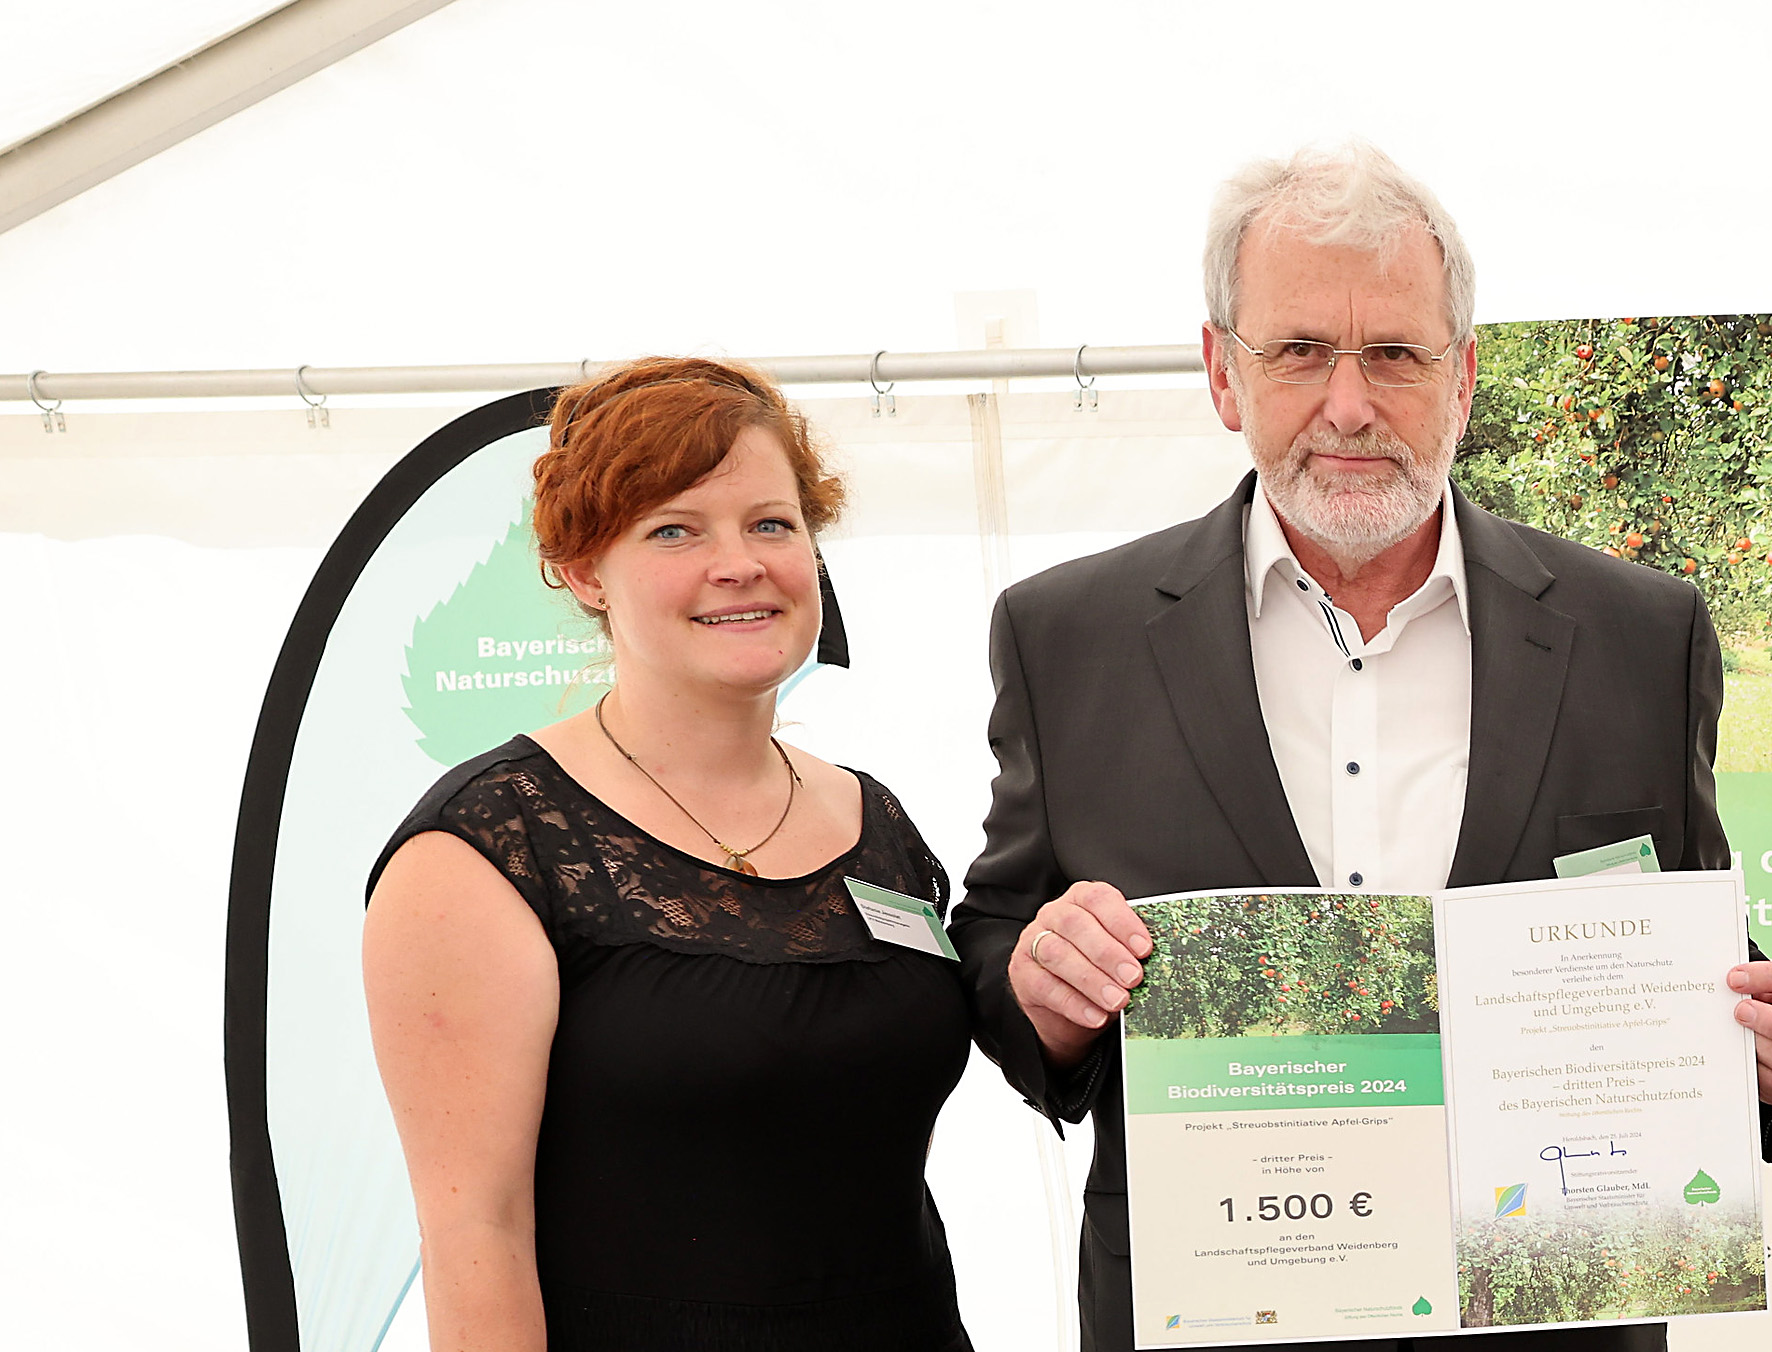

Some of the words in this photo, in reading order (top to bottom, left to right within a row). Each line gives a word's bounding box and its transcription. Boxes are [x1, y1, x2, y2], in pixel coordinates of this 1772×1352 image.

[1529, 918, 1653, 943] URKUNDE
[1560, 953, 1569, 962] In
[1570, 951, 1622, 962] Anerkennung
[1512, 967, 1553, 977] besonderer
[1554, 964, 1594, 974] Verdienste
[1609, 961, 1625, 970] den
[1626, 958, 1673, 968] Naturschutz
[1562, 974, 1592, 984] verleihe
[1593, 973, 1605, 982] ich
[1607, 972, 1624, 981] dem
[1475, 985, 1637, 1006] Landschaftspflegeverband
[1640, 980, 1716, 994] Weidenberg
[1533, 1006, 1557, 1018] und
[1562, 1001, 1631, 1017] Umgebung
[1634, 999, 1656, 1011] e.V.
[1520, 1026, 1547, 1035] Projekt
[1589, 1043, 1604, 1052] den
[1228, 1060, 1347, 1078] Bayerischer
[1492, 1064, 1562, 1081] Bayerischen
[1565, 1058, 1675, 1075] Biodiversitätspreis
[1678, 1055, 1705, 1068] 2024
[1167, 1080, 1355, 1100] Biodiversitätspreis
[1361, 1079, 1407, 1094] 2024
[1563, 1079, 1603, 1091] dritten
[1606, 1076, 1635, 1088] Preis
[1499, 1101, 1518, 1111] des
[1522, 1096, 1592, 1112] Bayerischen
[1595, 1088, 1703, 1105] Naturschutzfonds
[1185, 1122, 1223, 1132] Projekt
[1260, 1154, 1294, 1163] dritter
[1298, 1154, 1325, 1162] Preis
[1596, 1183, 1630, 1193] Glauber,
[1219, 1193, 1334, 1223] 1.500
[1349, 1191, 1374, 1218] €
[1279, 1234, 1292, 1242] an
[1295, 1233, 1315, 1241] den
[1195, 1243, 1334, 1257] Landschaftspflegeverband
[1337, 1241, 1398, 1251] Weidenberg
[1247, 1258, 1267, 1266] und
[1270, 1256, 1326, 1267] Umgebung
[1329, 1254, 1348, 1263] e.V.
